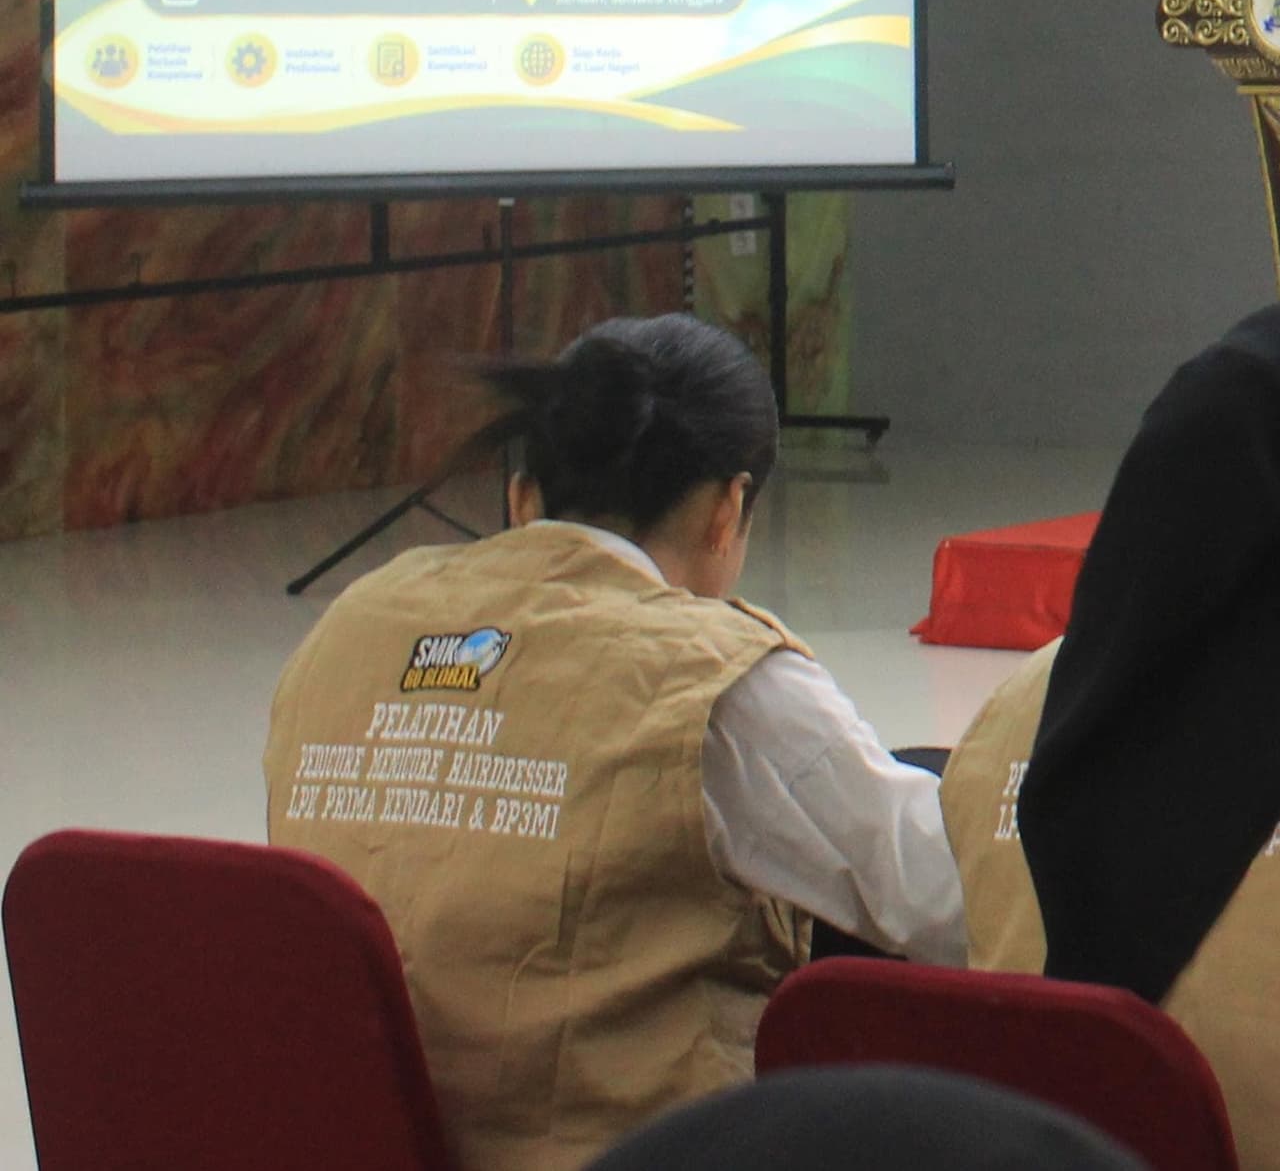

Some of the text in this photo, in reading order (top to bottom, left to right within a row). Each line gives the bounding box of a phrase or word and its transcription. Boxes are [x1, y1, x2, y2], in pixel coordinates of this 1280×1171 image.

[414, 636, 463, 667] SMK
[366, 702, 504, 745] PELATIHAN
[296, 743, 366, 780] PEDICURE
[445, 751, 568, 797] HAIRDRESSER
[287, 784, 561, 840] LPK PRIMA KENDARI & BP3MI
